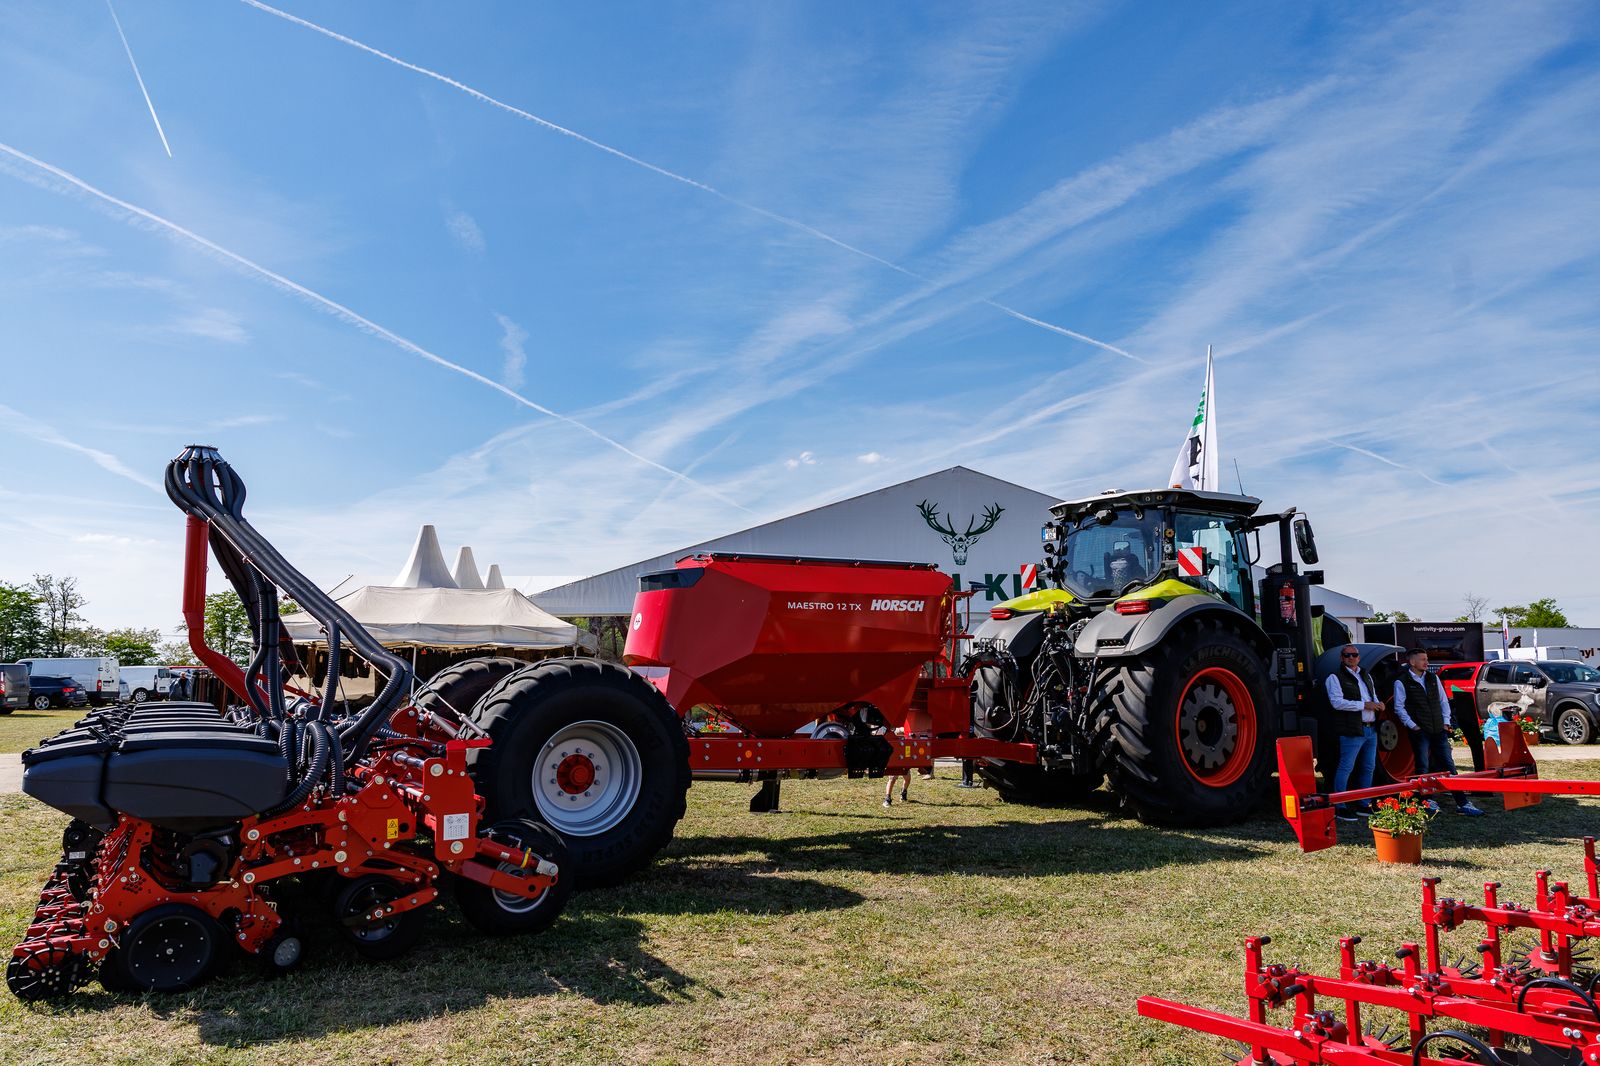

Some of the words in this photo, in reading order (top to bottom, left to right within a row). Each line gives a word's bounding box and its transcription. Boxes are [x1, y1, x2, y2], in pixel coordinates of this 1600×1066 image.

[788, 601, 834, 610] MAESTRO
[837, 603, 847, 611] 12
[849, 603, 862, 611] TX
[871, 599, 925, 612] HORSCH
[1198, 646, 1256, 675] MICHELIN
